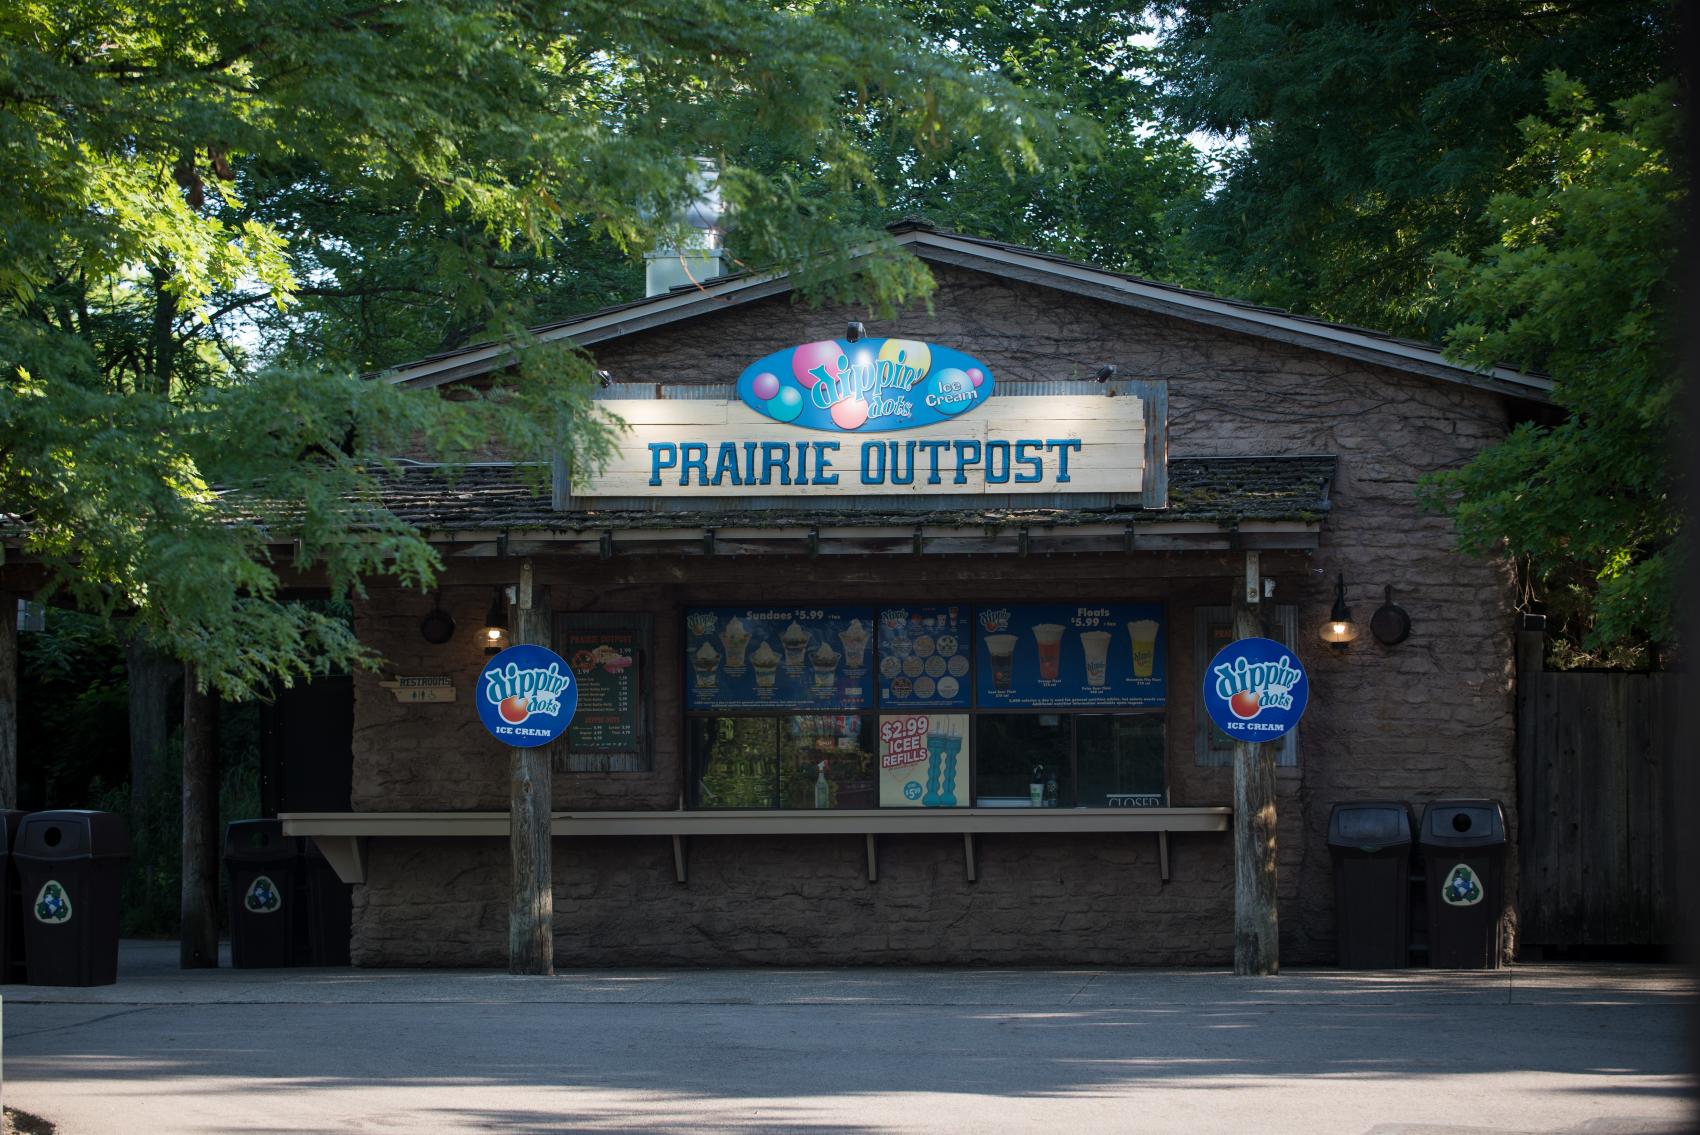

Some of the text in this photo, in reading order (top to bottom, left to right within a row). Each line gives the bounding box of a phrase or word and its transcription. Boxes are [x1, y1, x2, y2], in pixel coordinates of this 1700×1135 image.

[808, 350, 925, 409] dippin'
[938, 381, 962, 393] Ice
[867, 396, 913, 419] dots
[926, 389, 978, 408] Cream
[648, 438, 1081, 486] PRAIRIE OUTPOST
[746, 610, 792, 620] Sundaes
[795, 610, 824, 620] $5.99
[1077, 607, 1110, 617] Floats
[1071, 617, 1099, 627] $5.99
[400, 677, 451, 687] RESTROOMS
[485, 662, 570, 704] dippin'
[1214, 655, 1302, 700] dippin'
[526, 697, 561, 716] dots
[1259, 691, 1294, 710] dots
[496, 726, 551, 737] ICE CREAM
[882, 717, 928, 742] $2.99
[1227, 722, 1284, 731] ICE CREAM
[889, 736, 920, 754] ICEE
[883, 749, 928, 768] REFILLS
